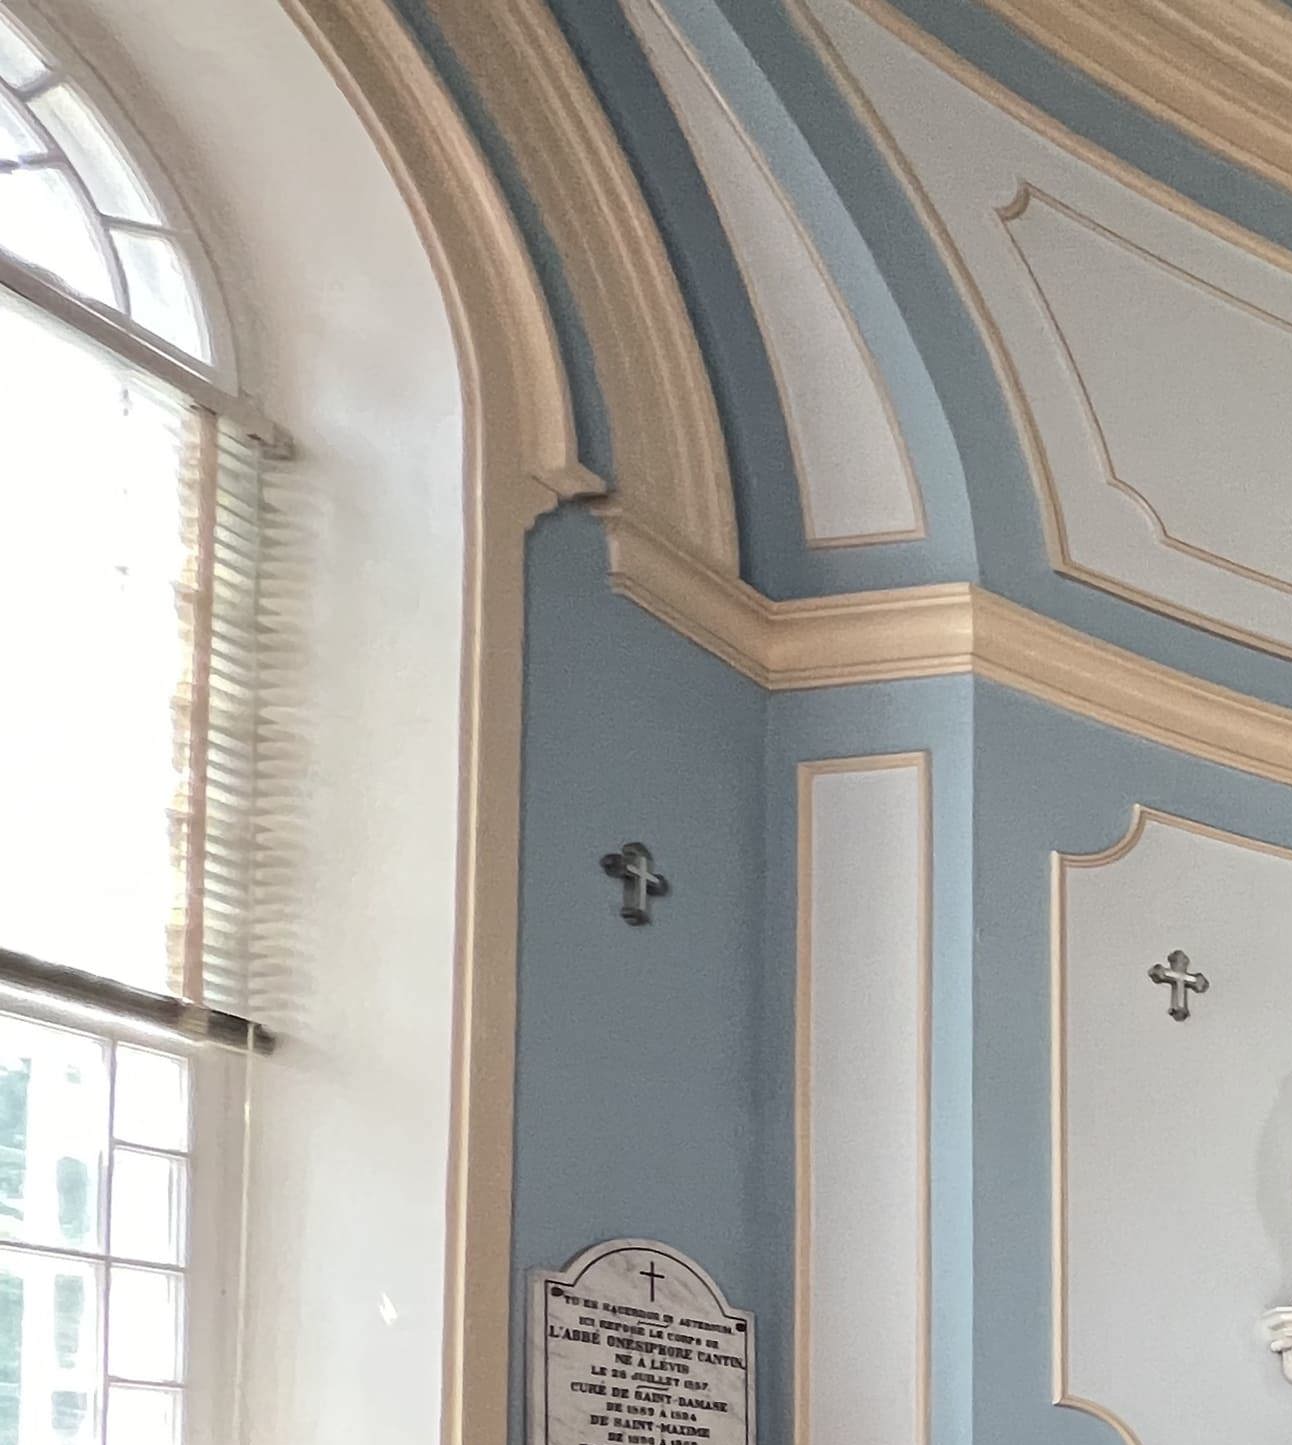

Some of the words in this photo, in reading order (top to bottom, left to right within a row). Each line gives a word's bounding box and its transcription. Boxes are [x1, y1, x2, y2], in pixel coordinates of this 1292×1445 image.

[649, 1329, 664, 1339] LE
[591, 1365, 608, 1377] LE
[631, 1372, 680, 1387] JUILLET
[570, 1380, 607, 1396] CURÉ
[611, 1387, 630, 1399] DE
[606, 1402, 622, 1412] DE
[590, 1414, 609, 1426] DE
[608, 1432, 623, 1442] DE
